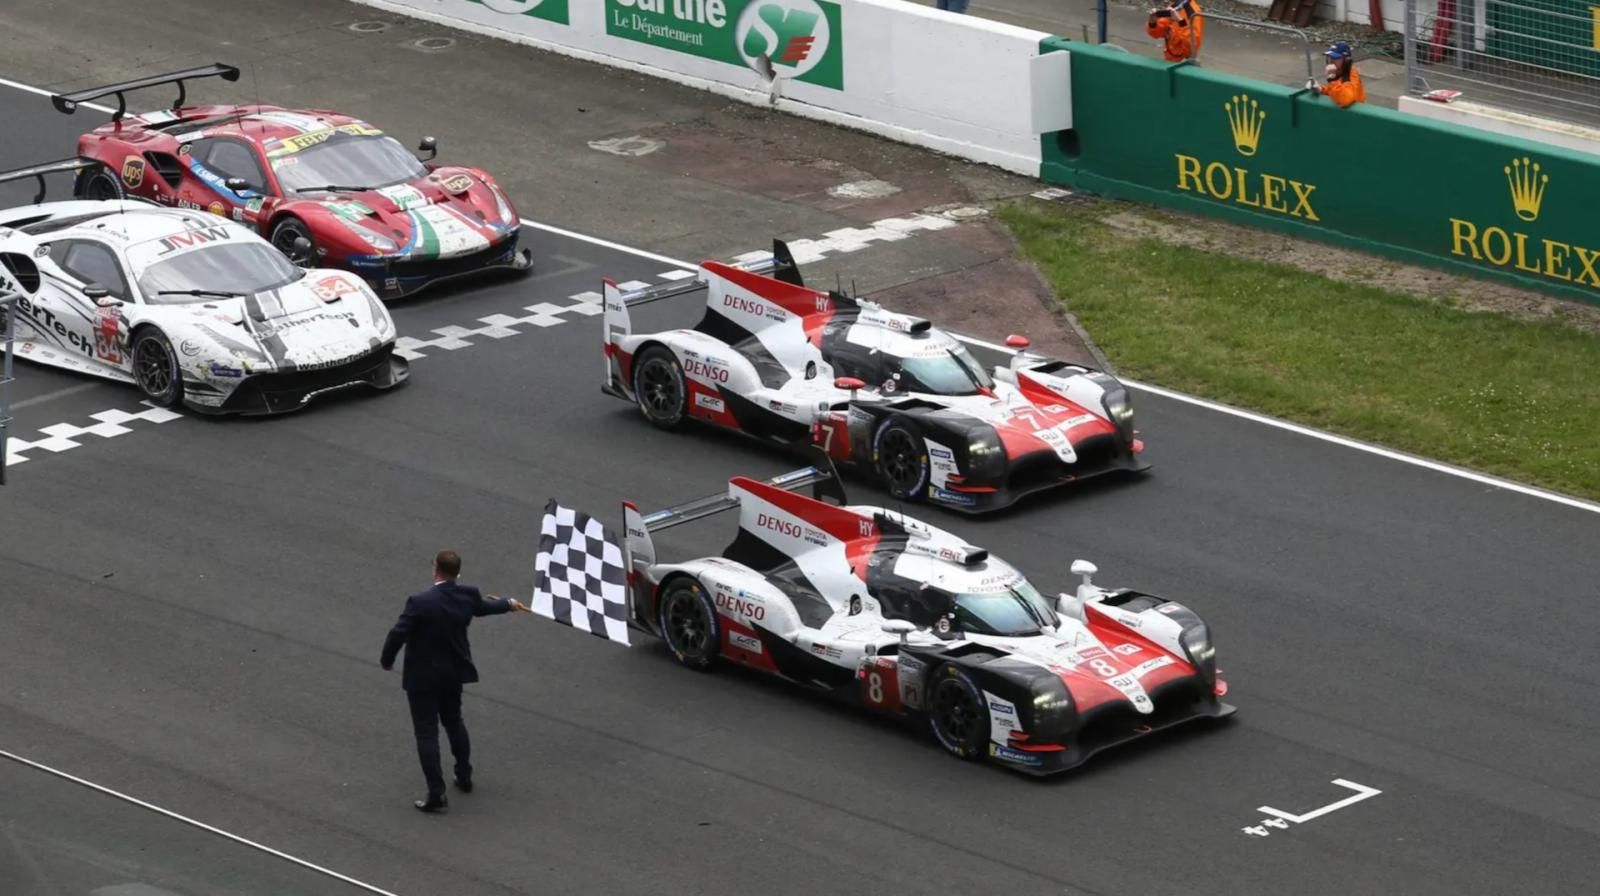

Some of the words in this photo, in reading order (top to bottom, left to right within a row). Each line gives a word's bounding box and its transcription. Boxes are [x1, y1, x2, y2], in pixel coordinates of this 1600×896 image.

[617, 0, 727, 28] the
[614, 10, 629, 28] Le
[632, 14, 703, 46] Département
[124, 164, 142, 183] ups
[1175, 154, 1320, 222] ROLEX
[158, 227, 231, 256] JMW
[1449, 218, 1600, 287] ROLEX
[724, 294, 764, 316] DENSO
[816, 296, 830, 313] HY
[684, 358, 729, 383] DENSO
[1016, 413, 1040, 432] 7
[821, 424, 834, 453] 7
[757, 513, 802, 538] DENSO
[860, 519, 874, 537] HY
[715, 592, 765, 621] DENSO
[1089, 658, 1118, 677] 8
[869, 672, 883, 704] 8
[1240, 817, 1289, 837] 44
